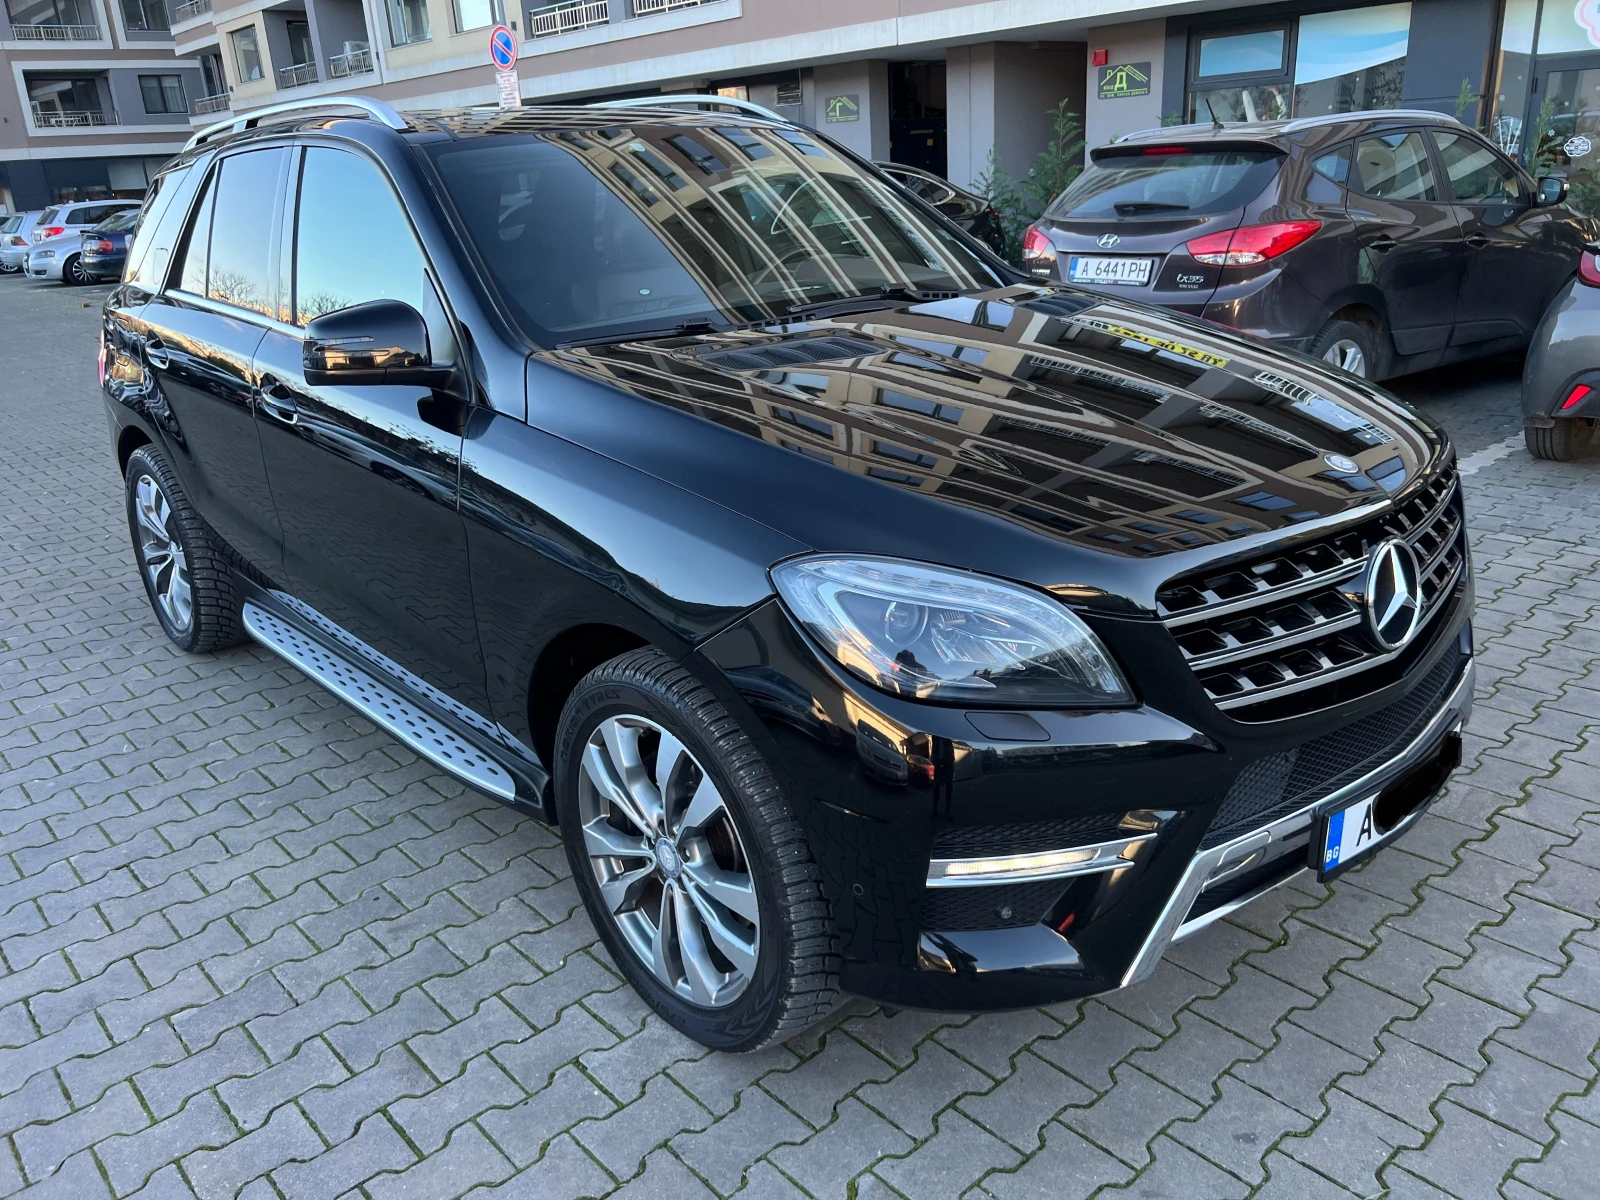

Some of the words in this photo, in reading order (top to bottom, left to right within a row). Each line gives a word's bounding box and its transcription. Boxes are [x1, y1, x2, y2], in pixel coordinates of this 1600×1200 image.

[1081, 260, 1089, 276] A
[1356, 803, 1372, 847] A
[1325, 845, 1340, 863] BG
